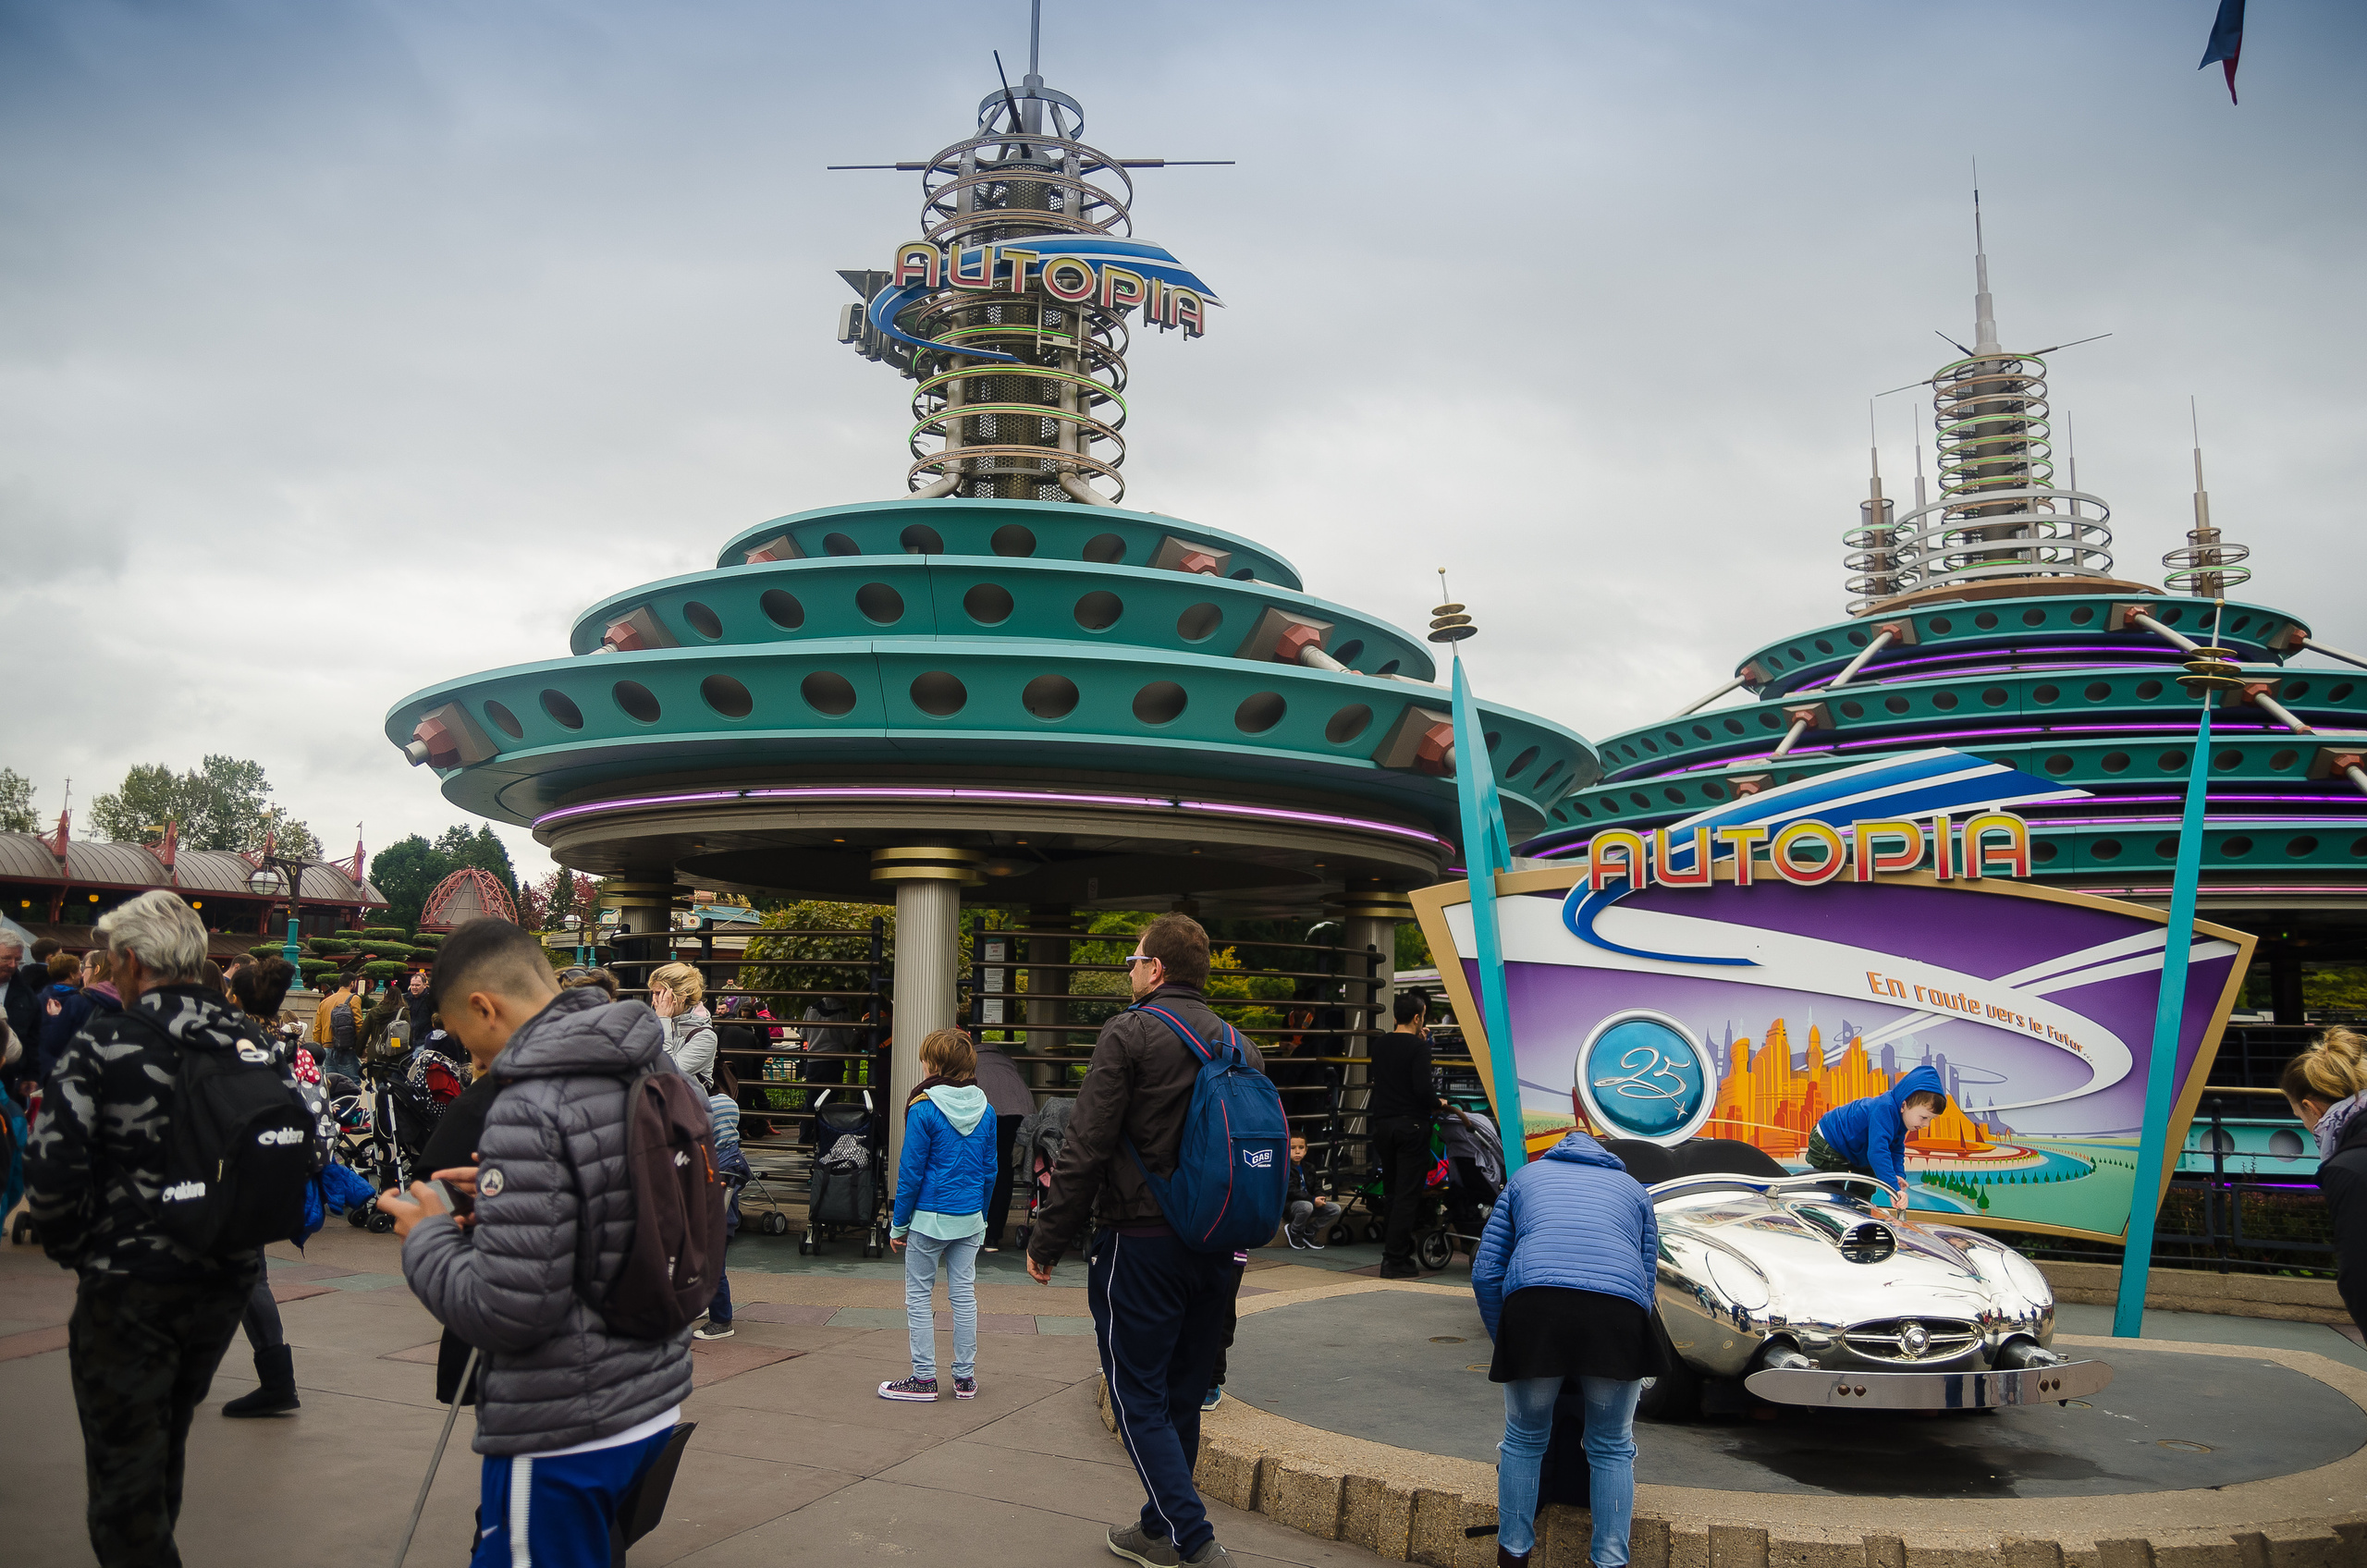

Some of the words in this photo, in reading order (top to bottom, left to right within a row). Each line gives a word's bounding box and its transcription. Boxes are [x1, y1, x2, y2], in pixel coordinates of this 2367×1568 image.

[892, 240, 1206, 339] AUTOPIA
[1588, 811, 2032, 891] AUTOPIA
[1866, 971, 1907, 998] En
[1914, 984, 1981, 1015] route
[1986, 1004, 2026, 1028] vers
[2029, 1017, 2043, 1035] le
[1594, 1047, 1691, 1100] 25
[1252, 1152, 1270, 1164] GAS
